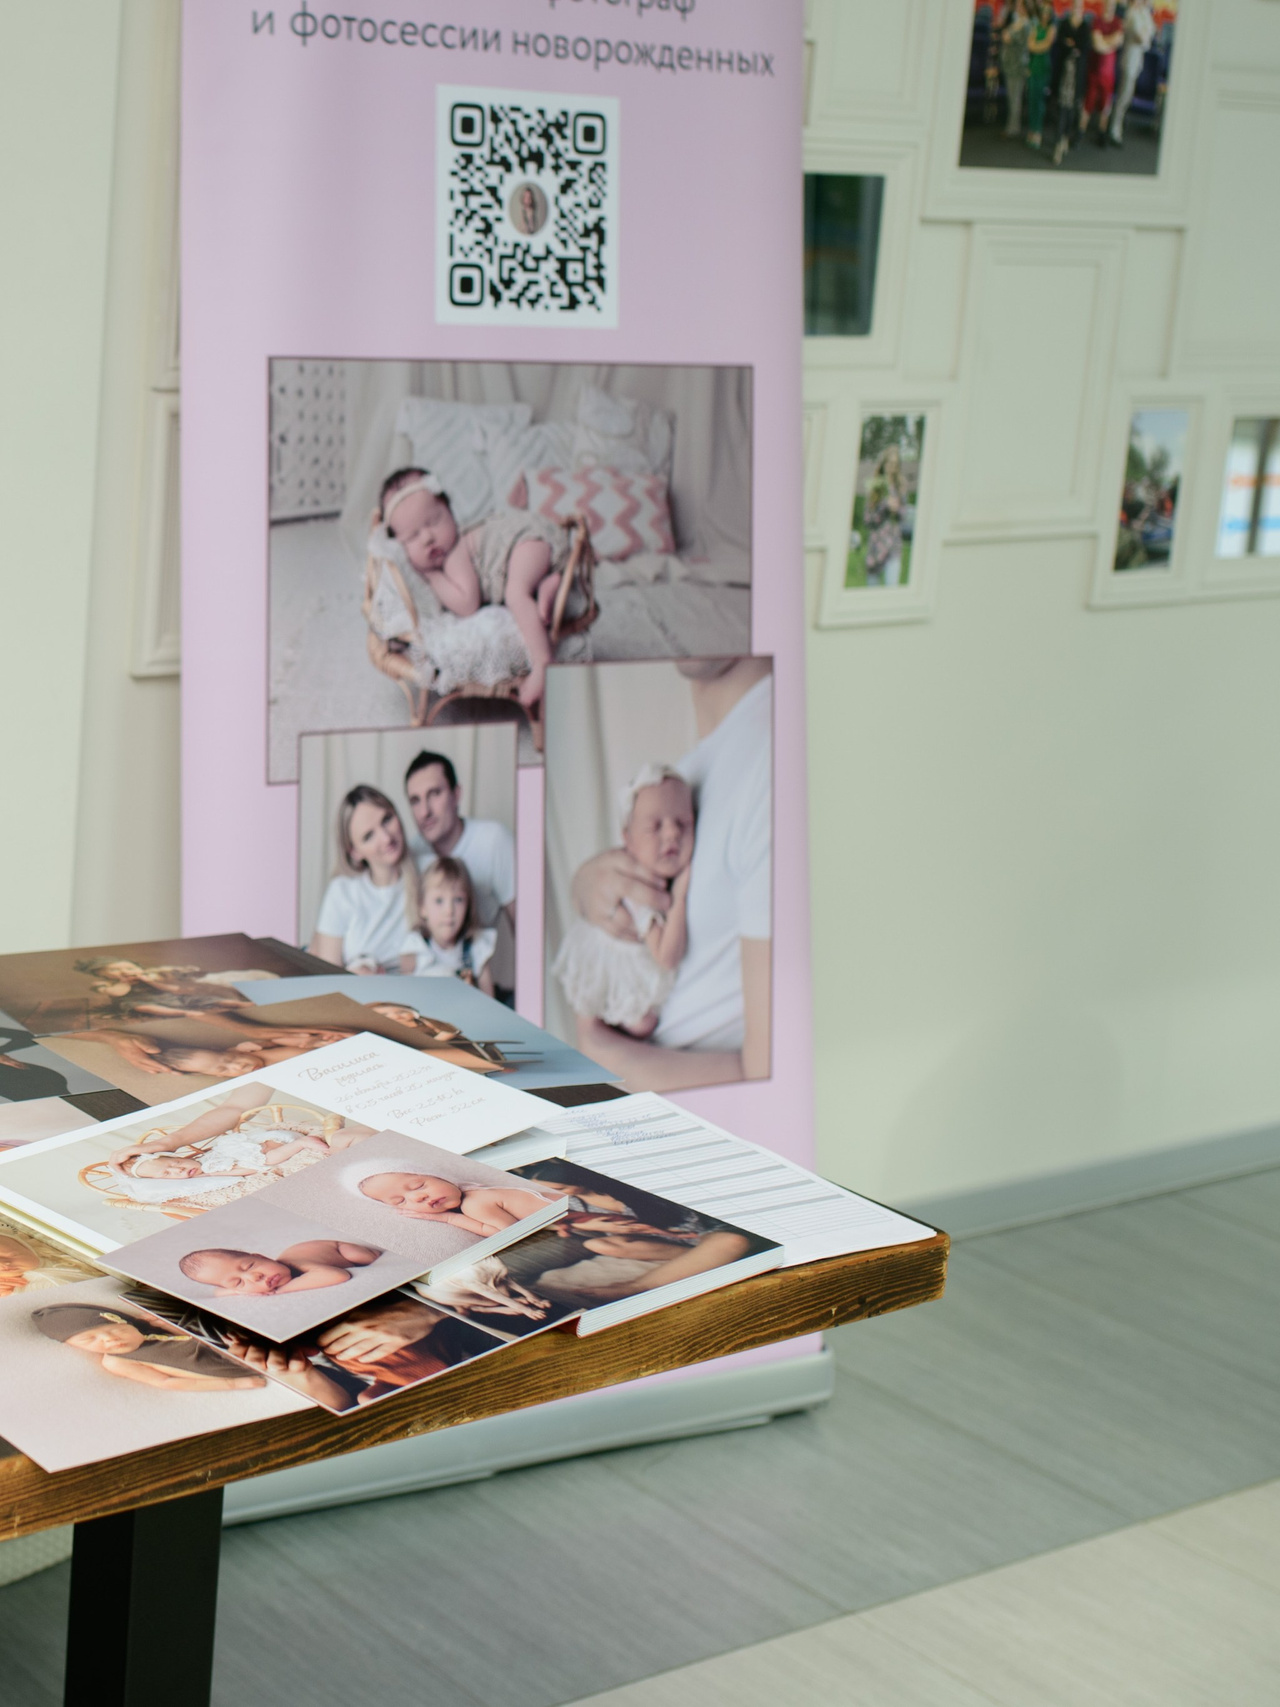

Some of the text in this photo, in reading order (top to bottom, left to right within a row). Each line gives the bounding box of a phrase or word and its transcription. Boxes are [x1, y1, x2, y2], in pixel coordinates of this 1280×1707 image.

[251, 12, 276, 36] и
[289, 0, 502, 54] фотосессии
[512, 29, 776, 77] новорожденных
[297, 1051, 380, 1081] Василиса
[334, 1063, 385, 1088] родилась
